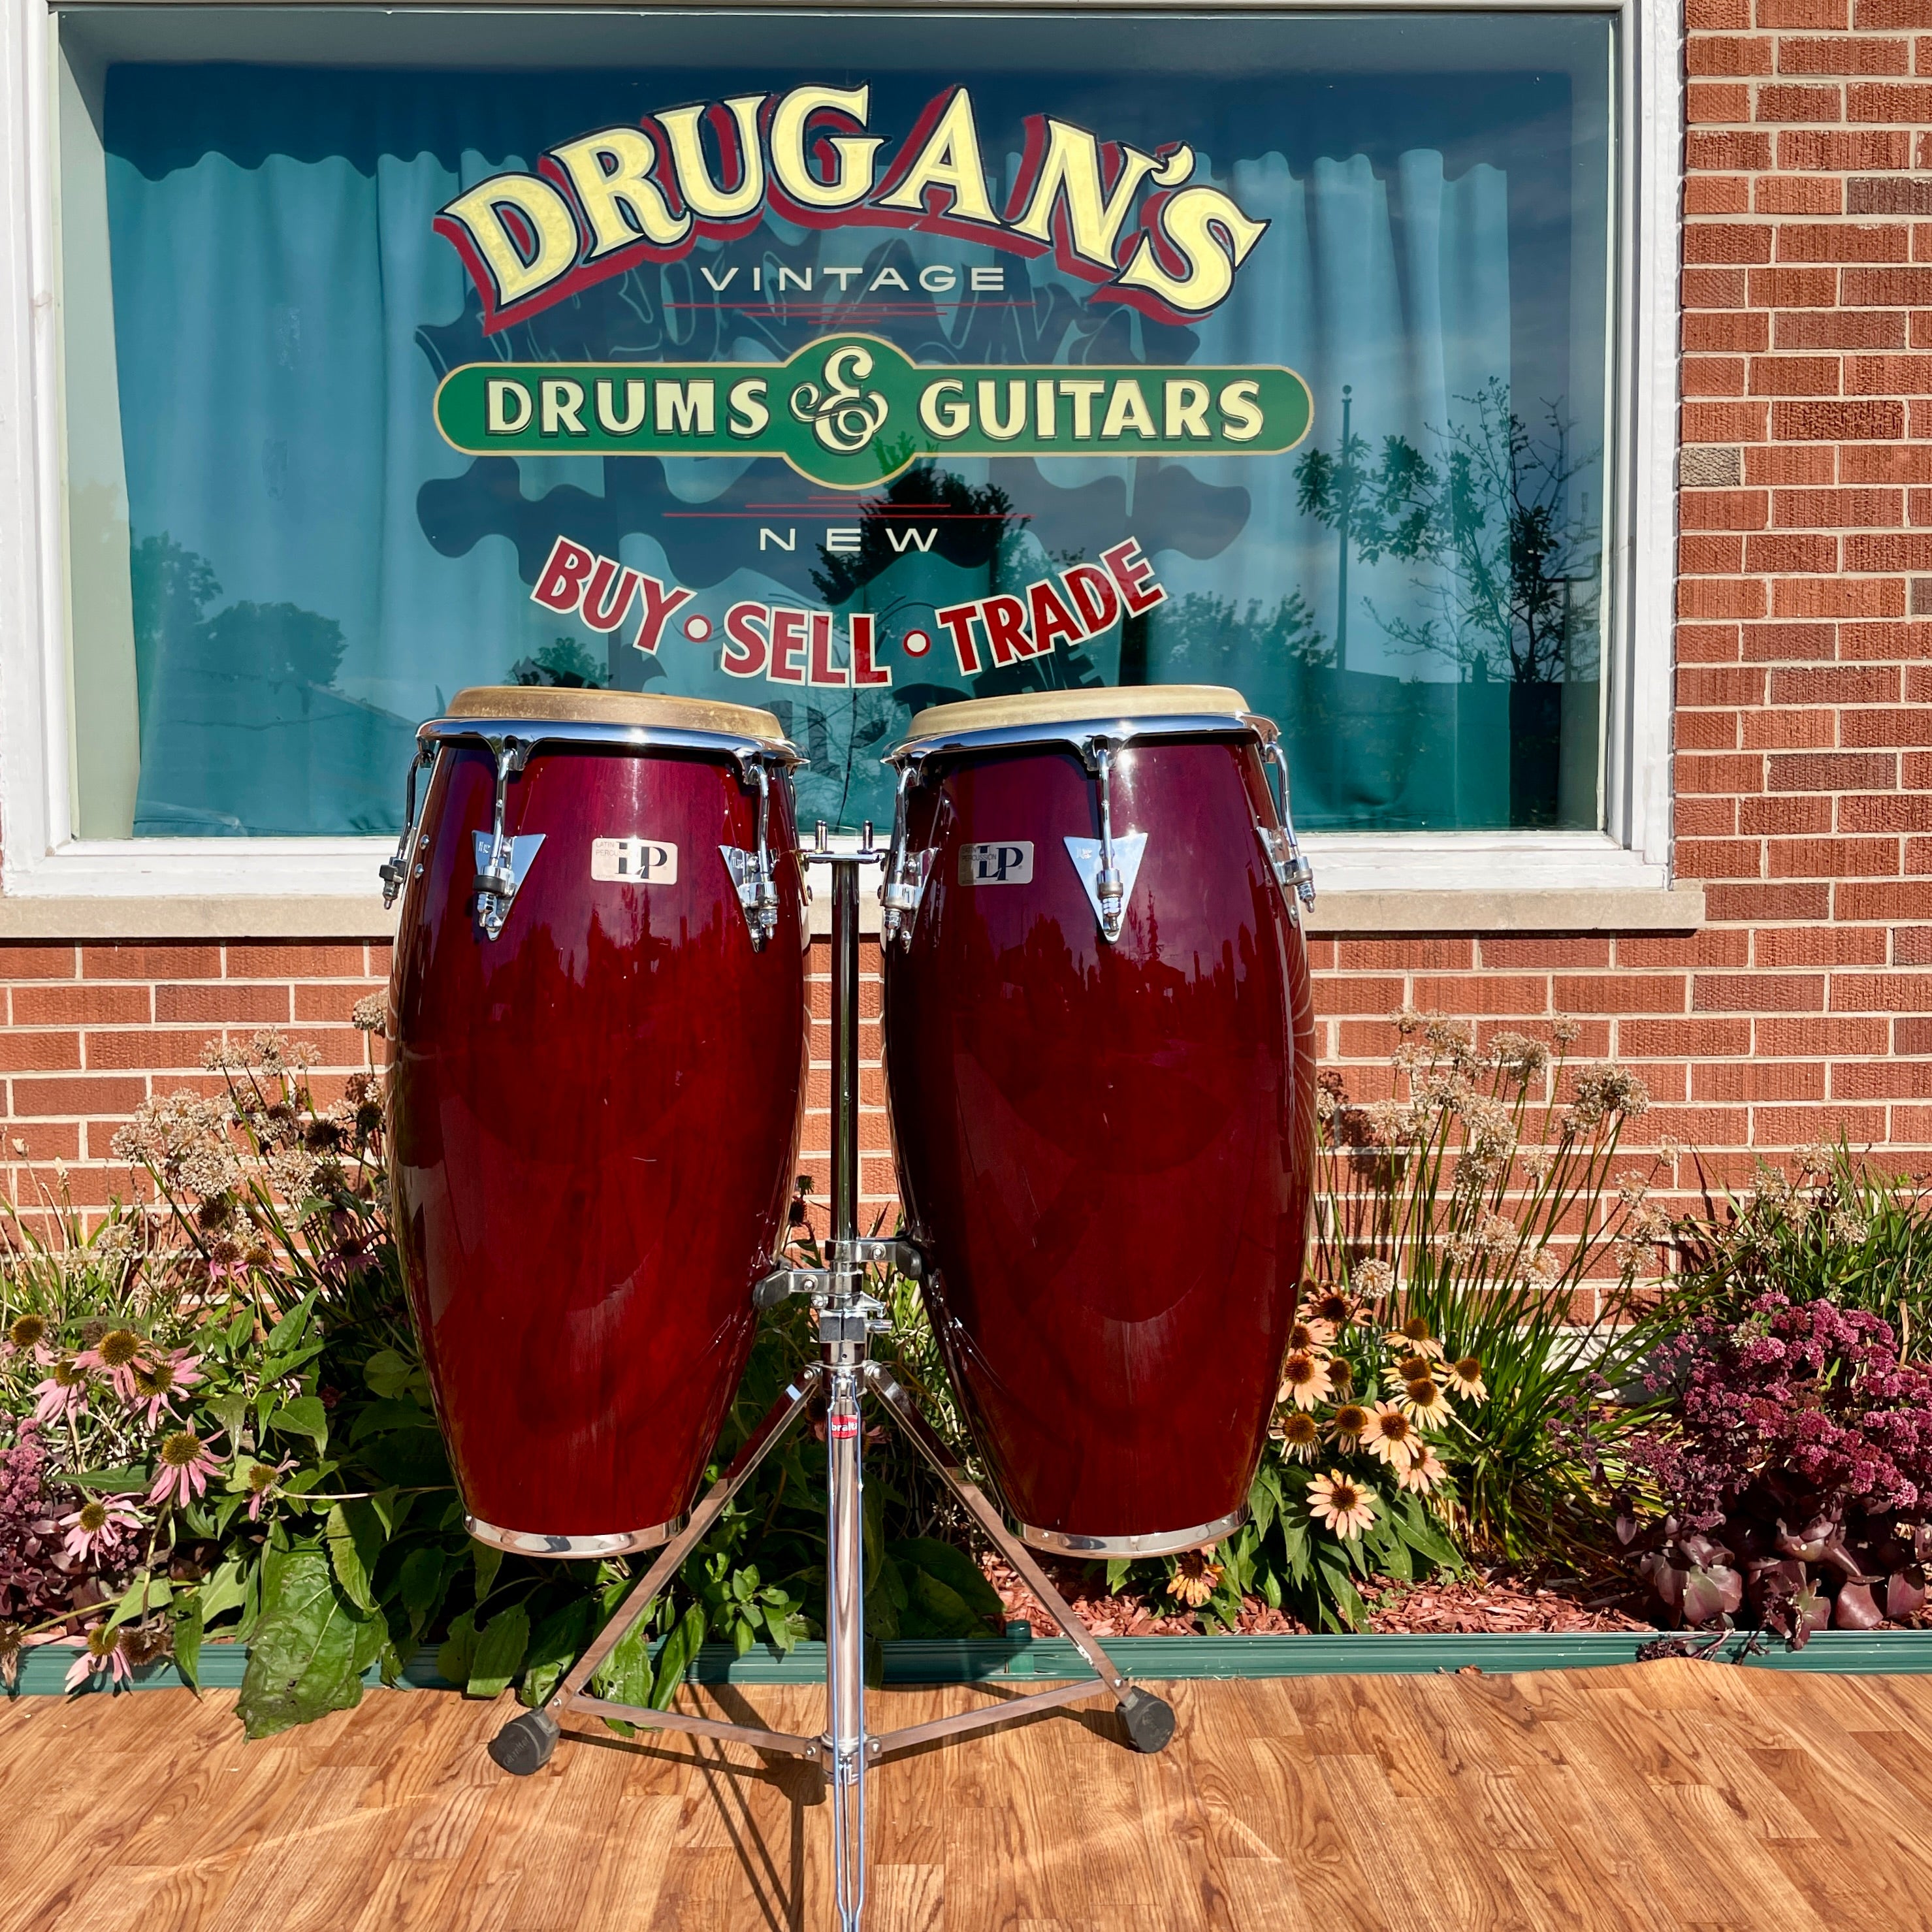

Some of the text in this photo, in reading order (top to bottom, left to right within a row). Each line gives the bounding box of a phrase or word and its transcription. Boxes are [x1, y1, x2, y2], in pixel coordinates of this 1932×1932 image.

[434, 80, 1272, 332] DRUGAN'S
[700, 267, 1005, 292] VINTAGE
[485, 346, 1264, 453] DRUMS & GUITARS
[760, 528, 938, 552] NEW
[530, 535, 1168, 688] BUY SELL TRADE
[976, 845, 1023, 881] LP
